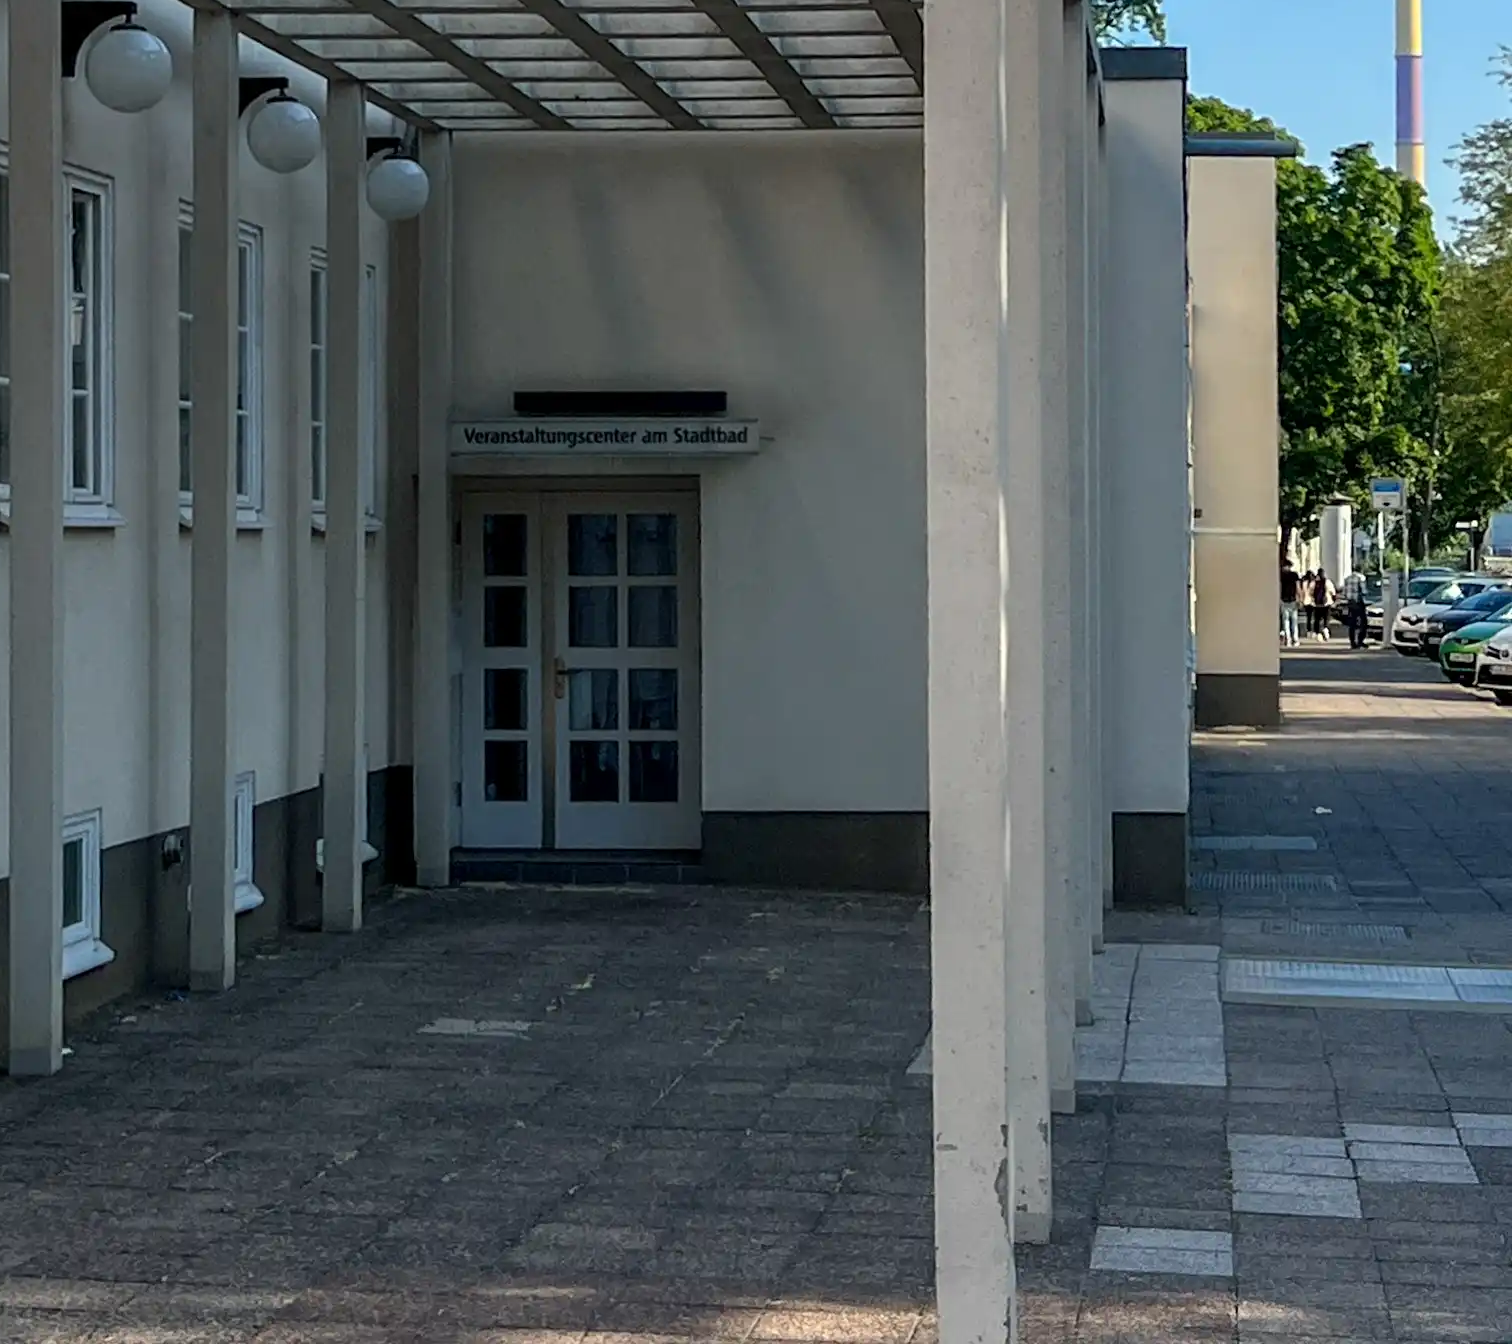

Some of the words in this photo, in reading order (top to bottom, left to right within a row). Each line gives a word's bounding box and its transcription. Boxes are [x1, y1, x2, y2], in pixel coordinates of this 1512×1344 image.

[463, 426, 637, 449] Veranstaltungscenter
[641, 429, 668, 444] am
[672, 426, 748, 444] Stadtbad
